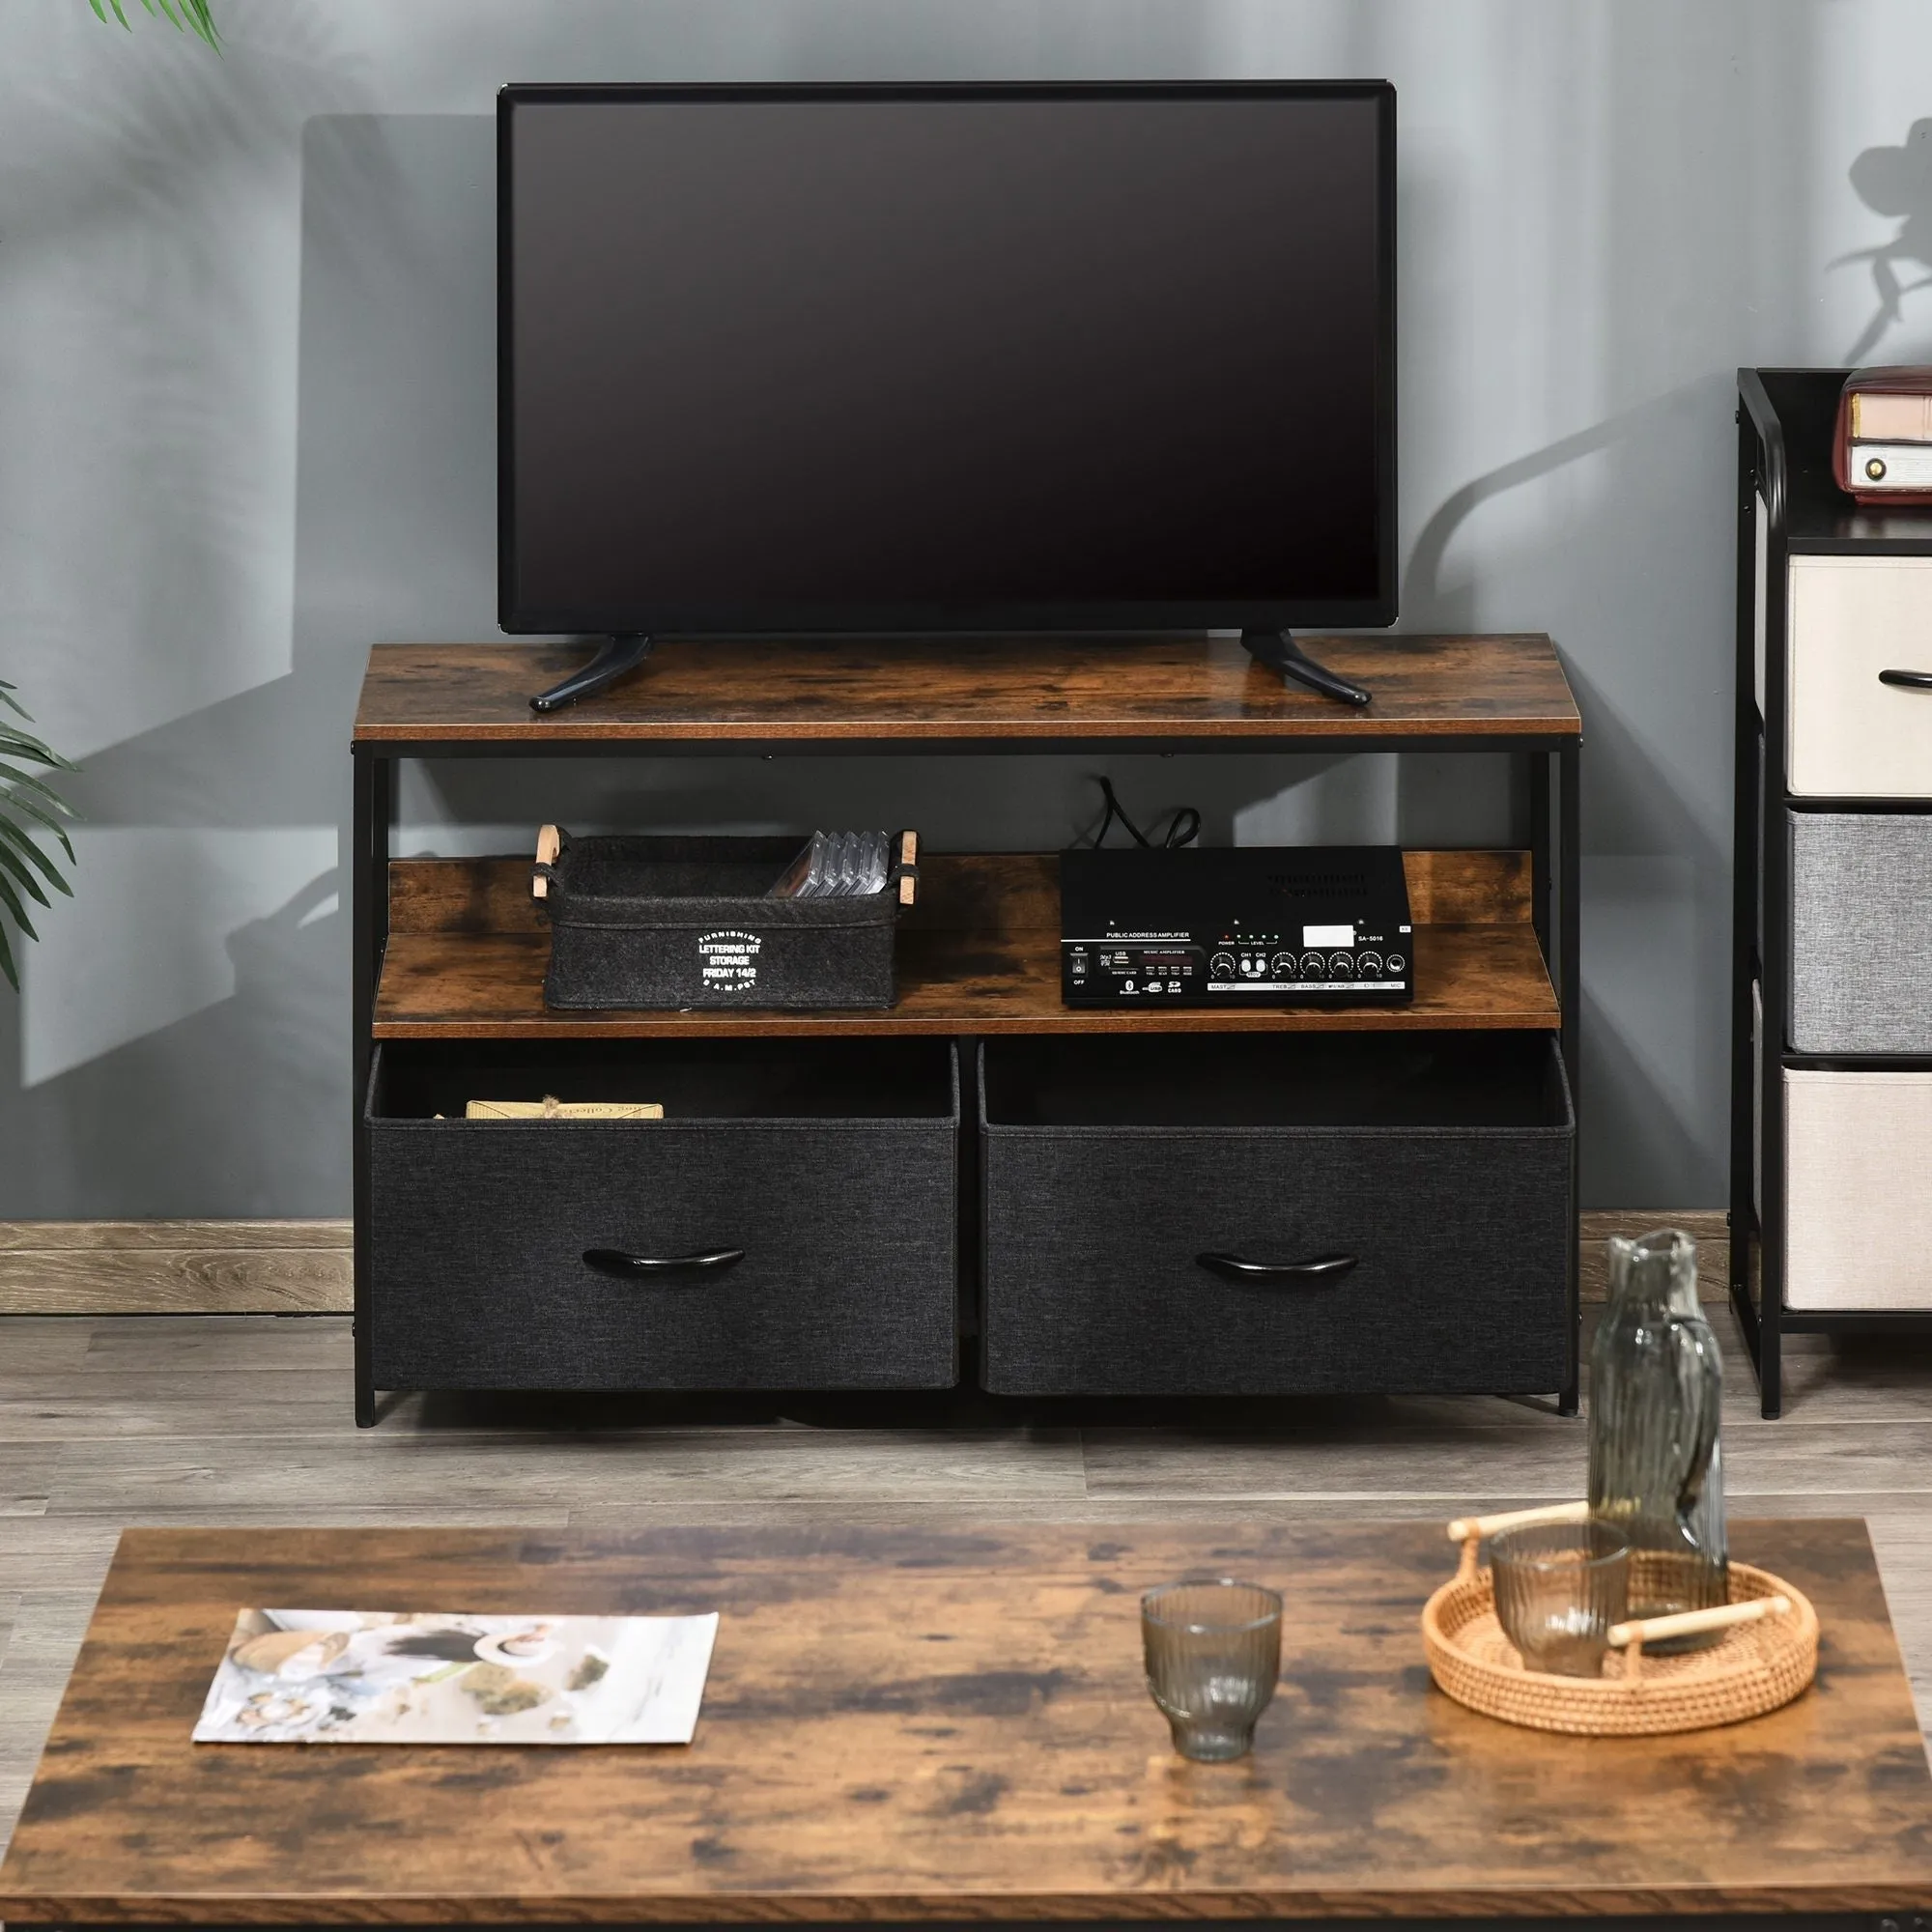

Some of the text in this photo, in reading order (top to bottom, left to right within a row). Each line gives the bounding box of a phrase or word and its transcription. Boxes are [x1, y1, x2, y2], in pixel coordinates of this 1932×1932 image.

[698, 944, 761, 953] LETTERING KIT
[709, 955, 750, 966] STORAGE
[702, 967, 756, 978] FRIDAY 14/2
